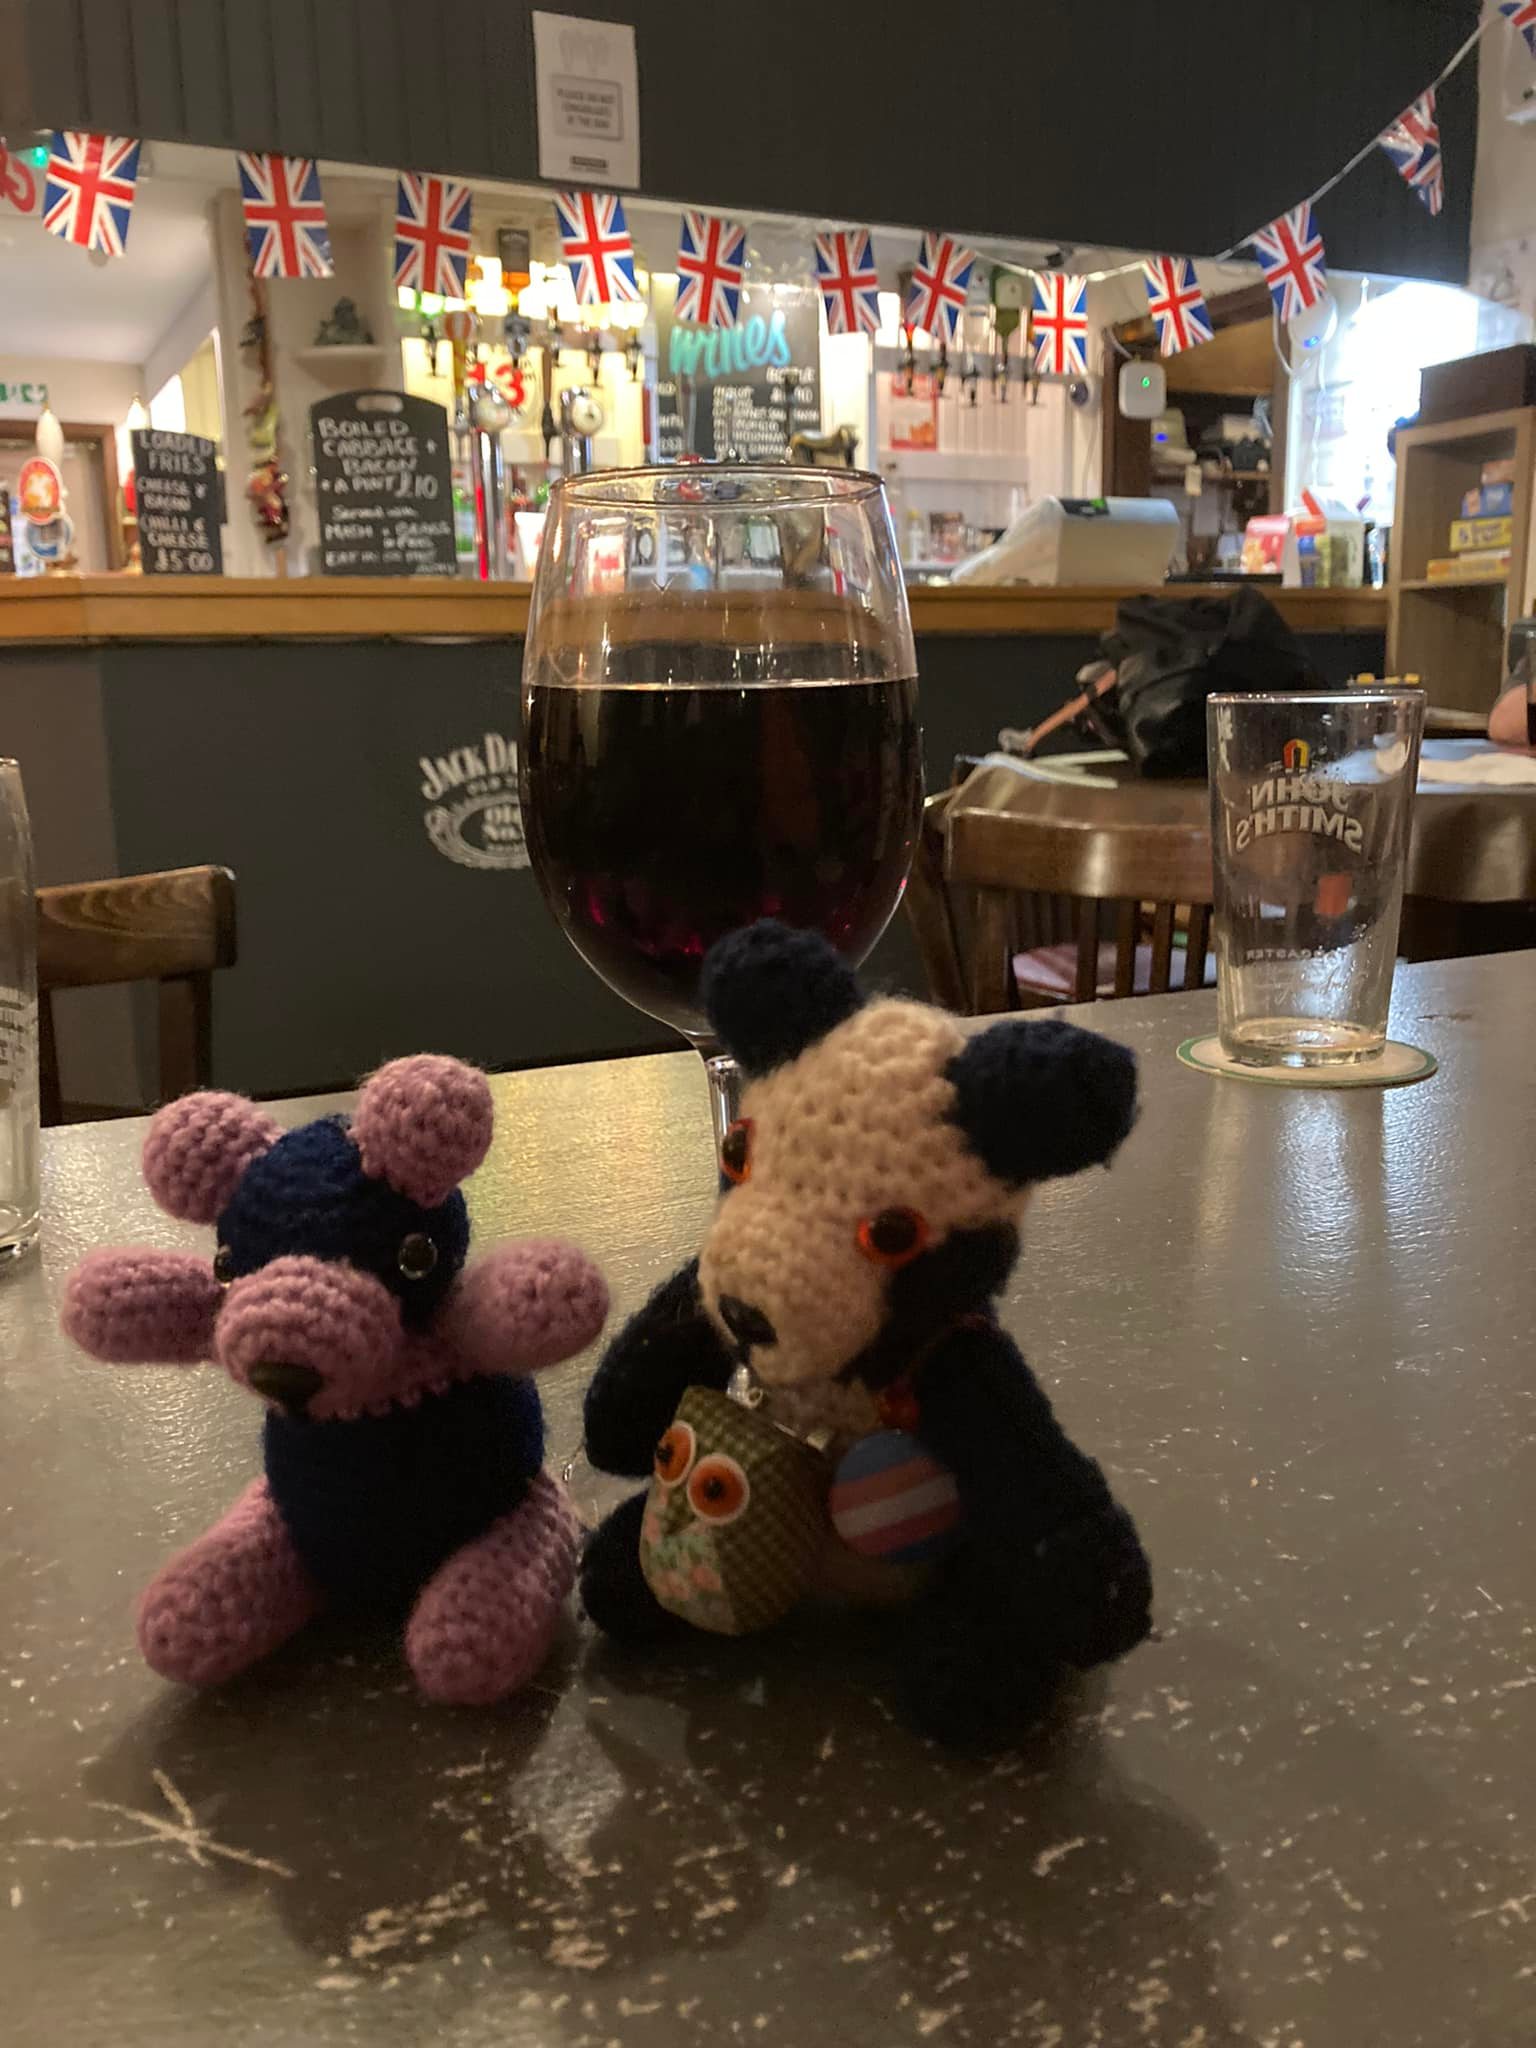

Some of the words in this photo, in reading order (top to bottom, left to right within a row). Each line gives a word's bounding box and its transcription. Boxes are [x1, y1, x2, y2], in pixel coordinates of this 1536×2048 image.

[317, 417, 410, 439] BOILED
[139, 430, 213, 457] LOADED
[322, 436, 420, 459] CABBAGE
[148, 449, 207, 475] FRIES
[341, 457, 418, 476] BACON
[333, 477, 350, 494] A
[351, 475, 395, 493] PINT
[394, 471, 439, 499] £10
[419, 745, 486, 800] JACK
